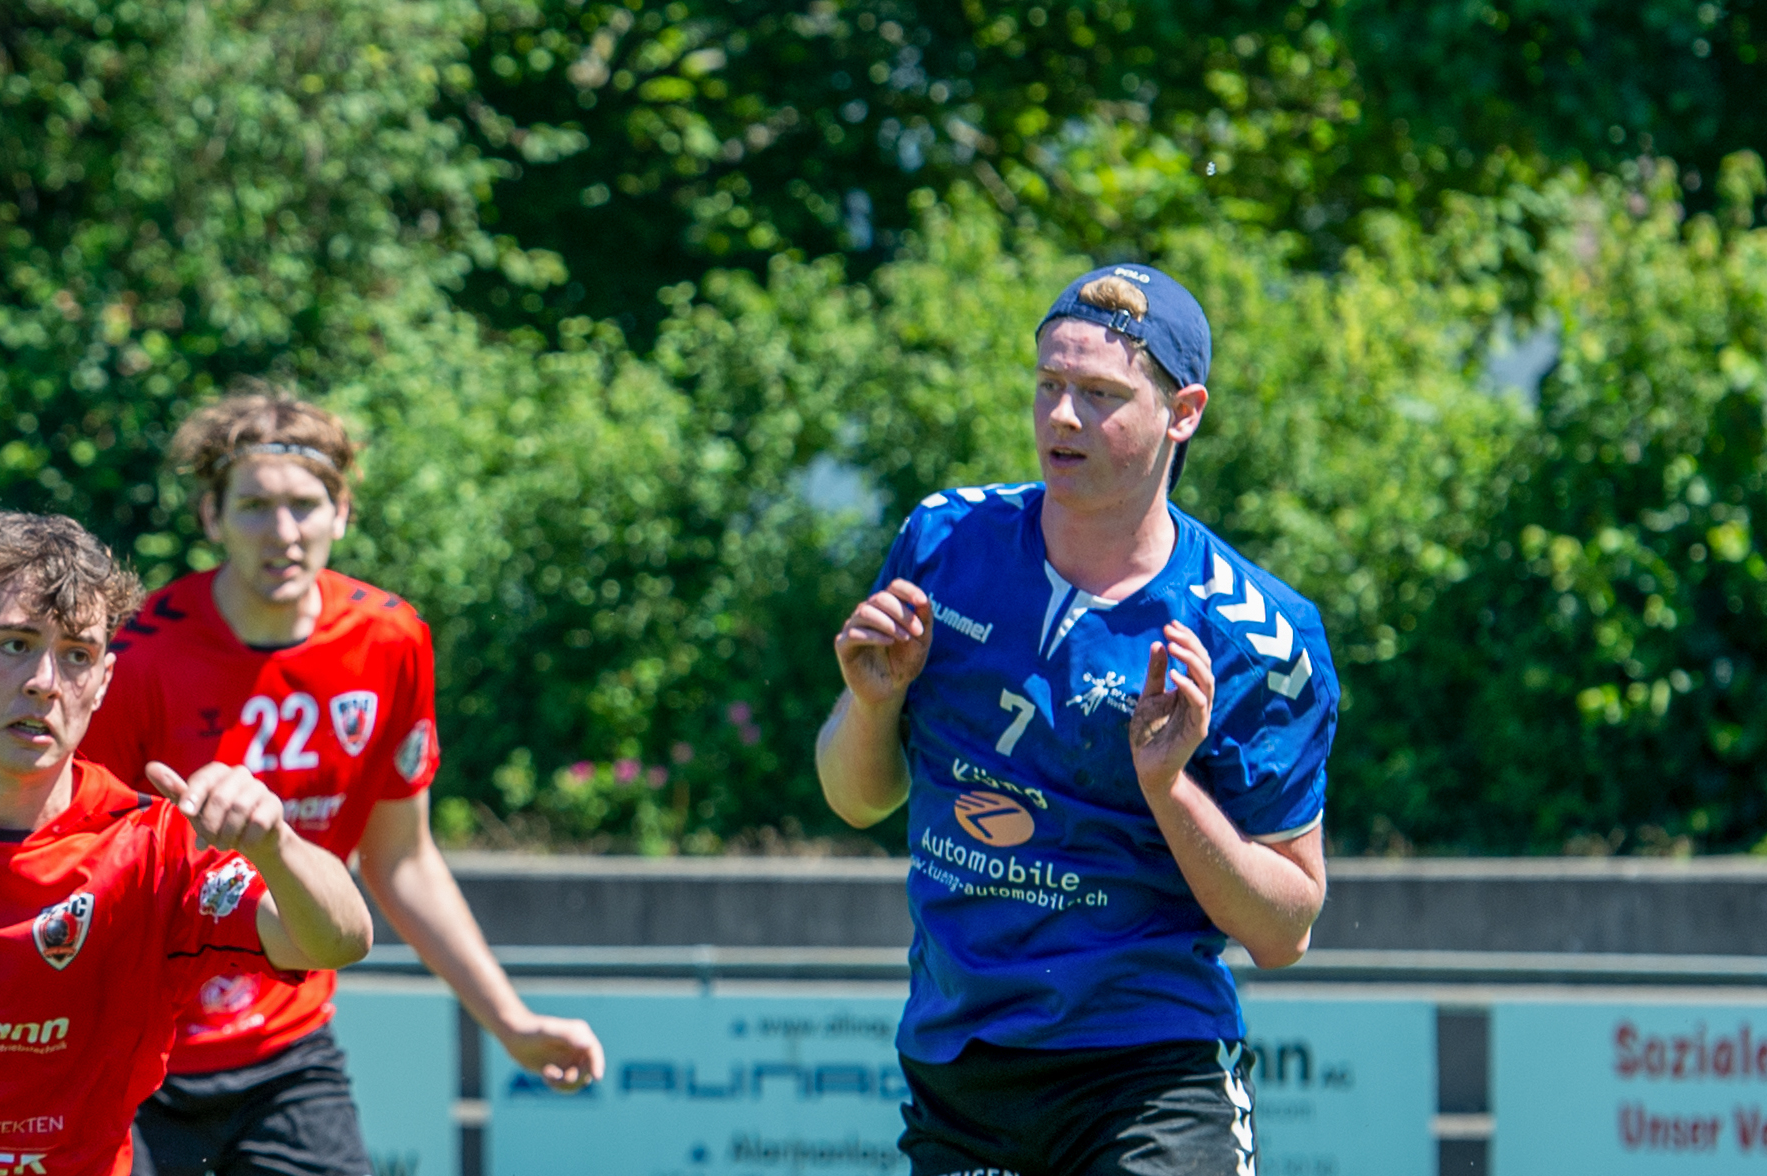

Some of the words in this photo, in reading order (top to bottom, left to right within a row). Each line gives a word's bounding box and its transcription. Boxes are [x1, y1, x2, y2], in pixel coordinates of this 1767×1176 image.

[240, 692, 320, 772] 22
[995, 689, 1036, 757] 7
[921, 826, 1081, 892] Automobile
